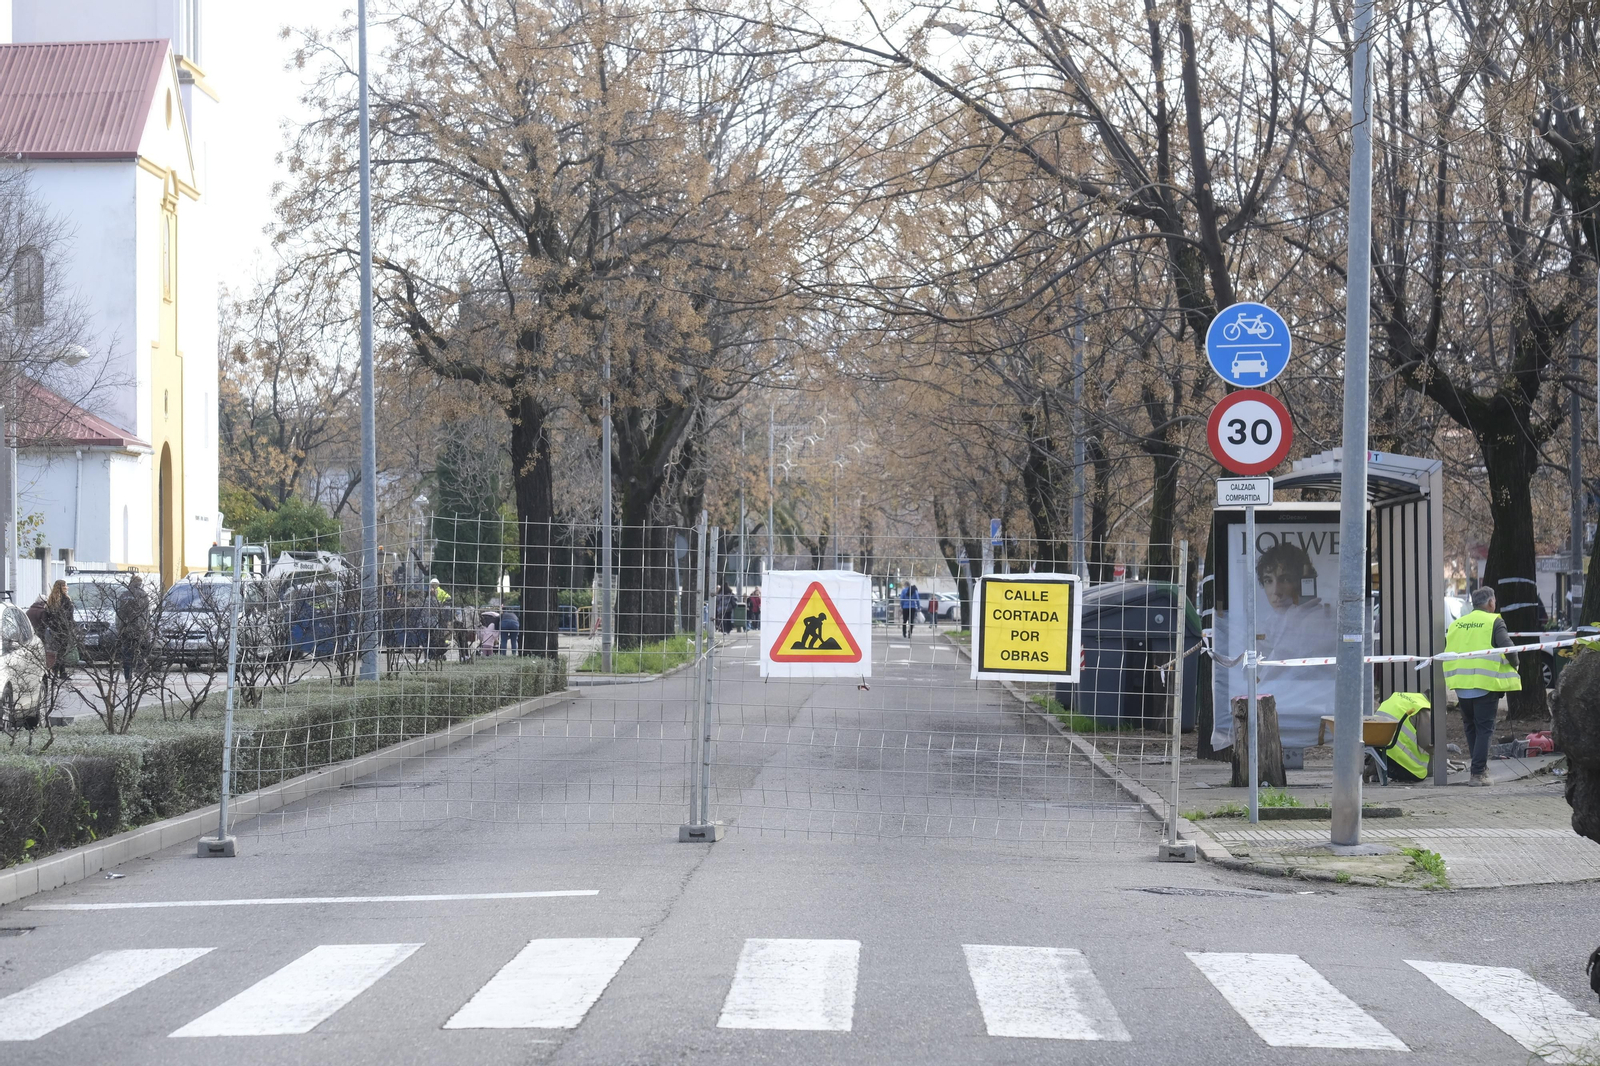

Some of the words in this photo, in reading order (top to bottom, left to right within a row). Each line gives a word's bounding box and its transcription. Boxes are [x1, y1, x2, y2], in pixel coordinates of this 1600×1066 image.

[1227, 418, 1273, 445] 30
[1004, 590, 1048, 602] CALLE
[993, 609, 1059, 622] CORTADA
[1458, 622, 1485, 630] Sepisur
[1011, 630, 1040, 642] POR
[1000, 650, 1049, 662] OBRAS
